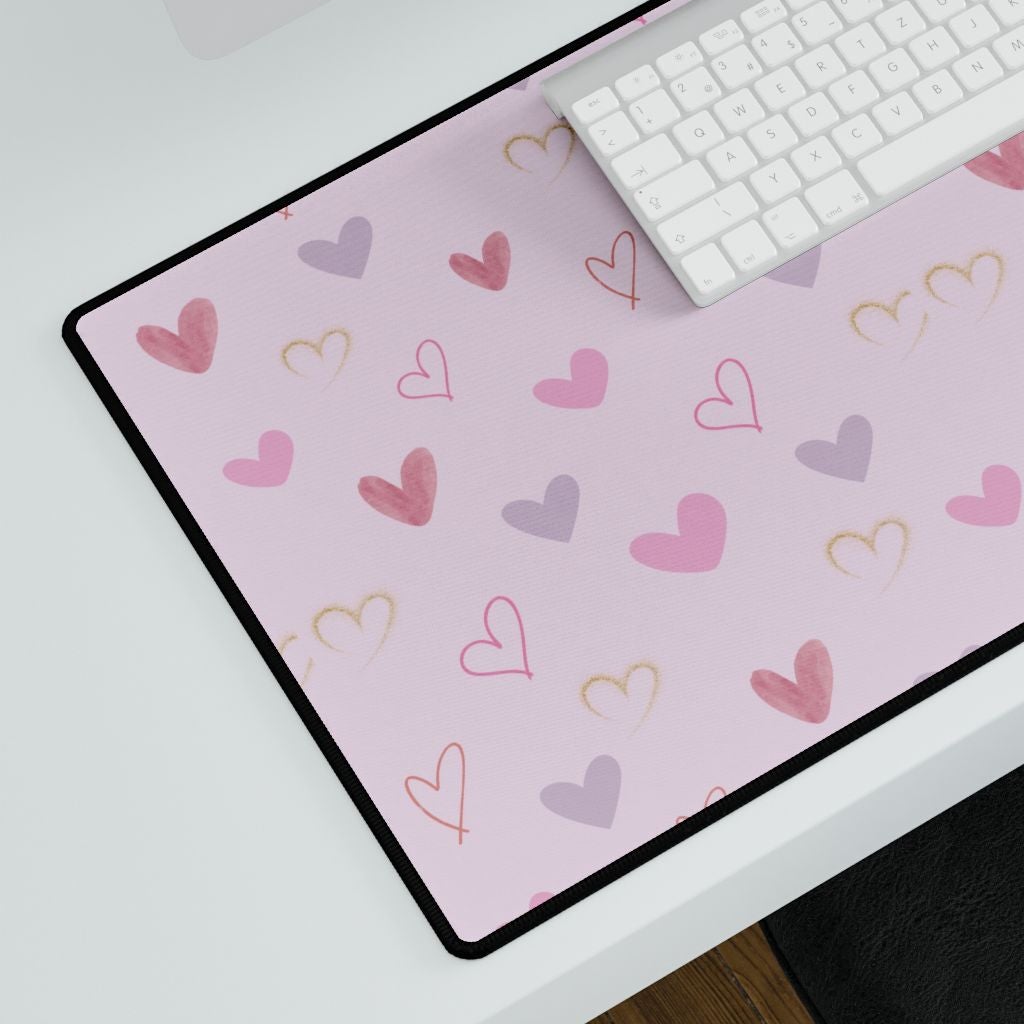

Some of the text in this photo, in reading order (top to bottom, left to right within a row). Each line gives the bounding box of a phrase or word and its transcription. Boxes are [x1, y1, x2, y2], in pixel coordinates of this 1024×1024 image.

[677, 82, 687, 94] 2
[718, 61, 727, 71] 3
[760, 38, 768, 47] 4
[799, 17, 808, 27] 5
[694, 128, 706, 137] Q
[733, 104, 746, 116] W
[775, 83, 786, 94] E
[816, 62, 827, 72] R
[856, 39, 865, 48] T
[896, 17, 908, 28] Z
[727, 152, 736, 163] A
[766, 129, 776, 139] S
[806, 107, 816, 118] D
[848, 84, 855, 94] F
[888, 62, 898, 72] G
[927, 40, 939, 51] H
[970, 17, 977, 29] J
[768, 172, 778, 183] Y
[808, 150, 822, 162] X
[851, 128, 862, 138] C
[890, 106, 900, 116] V
[931, 82, 942, 94] B
[971, 61, 984, 72] N
[1011, 40, 1024, 51] M
